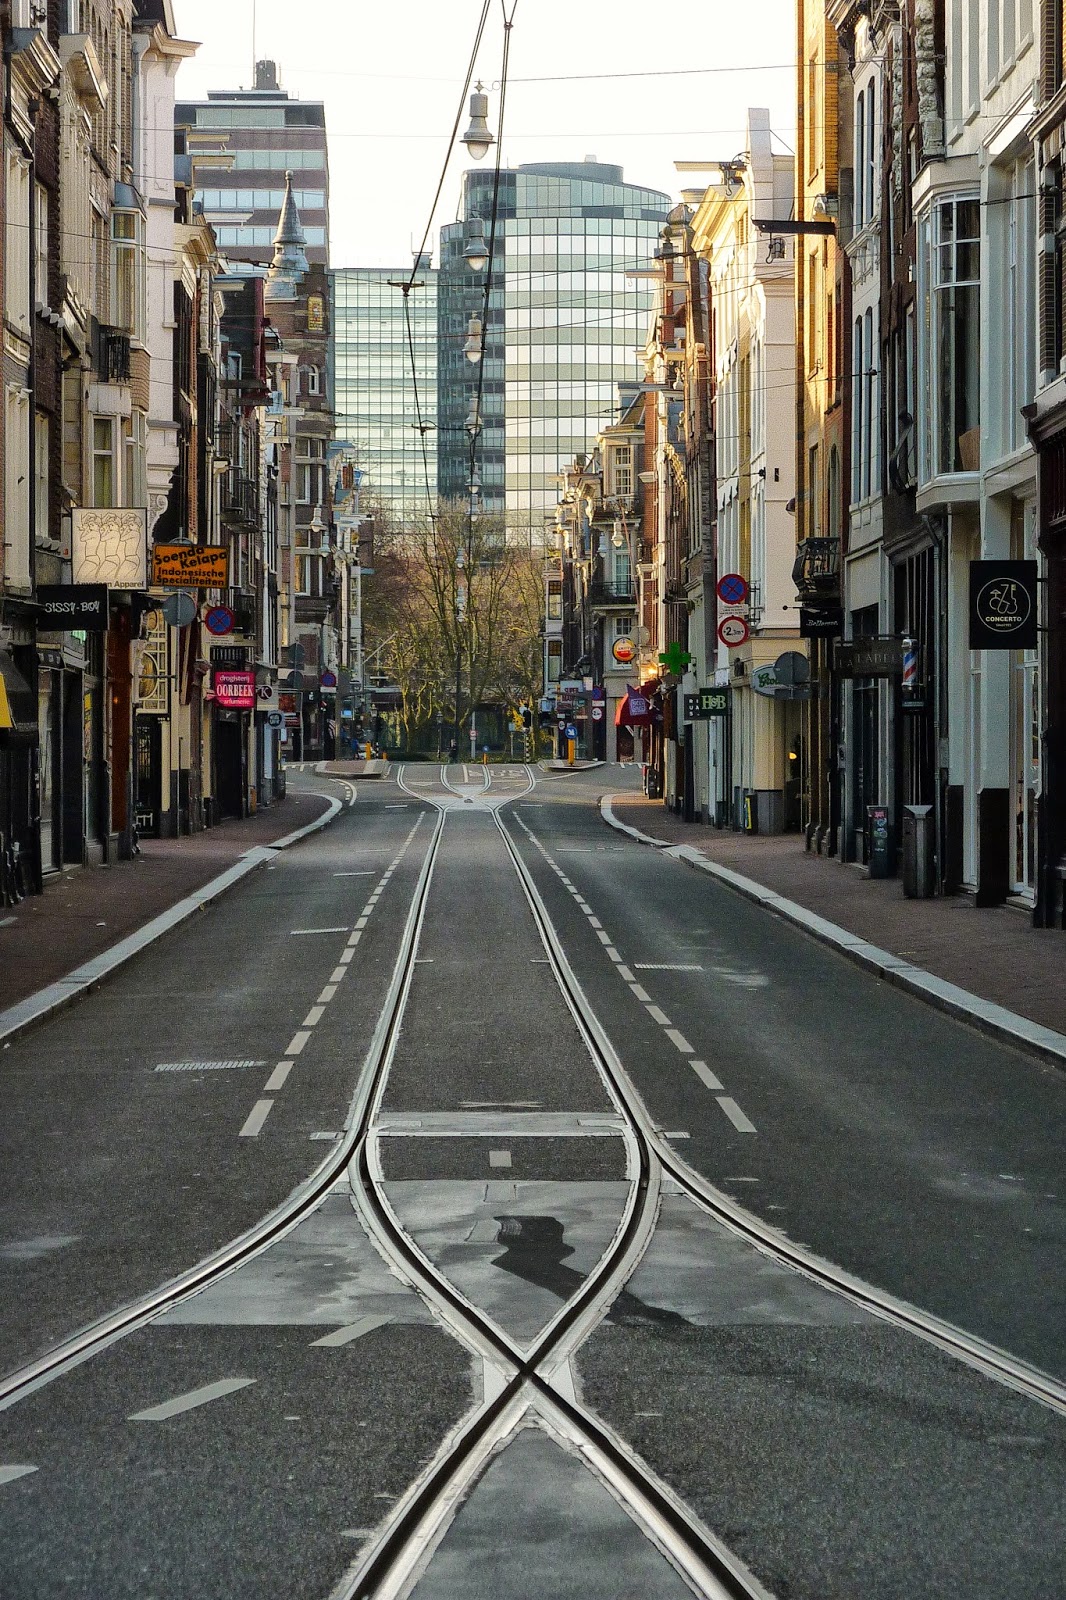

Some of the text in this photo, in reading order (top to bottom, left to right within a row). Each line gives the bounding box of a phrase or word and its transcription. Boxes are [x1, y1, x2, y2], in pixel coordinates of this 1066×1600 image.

[154, 544, 205, 565] Soenda
[179, 551, 227, 569] Kelapa
[157, 566, 224, 577] Indonesische
[113, 580, 145, 589] Apparel
[156, 574, 225, 586] Specialiteiten
[45, 601, 100, 615] SISSY-BOY
[219, 674, 250, 683] drogisterij
[216, 684, 254, 697] OORBEEK
